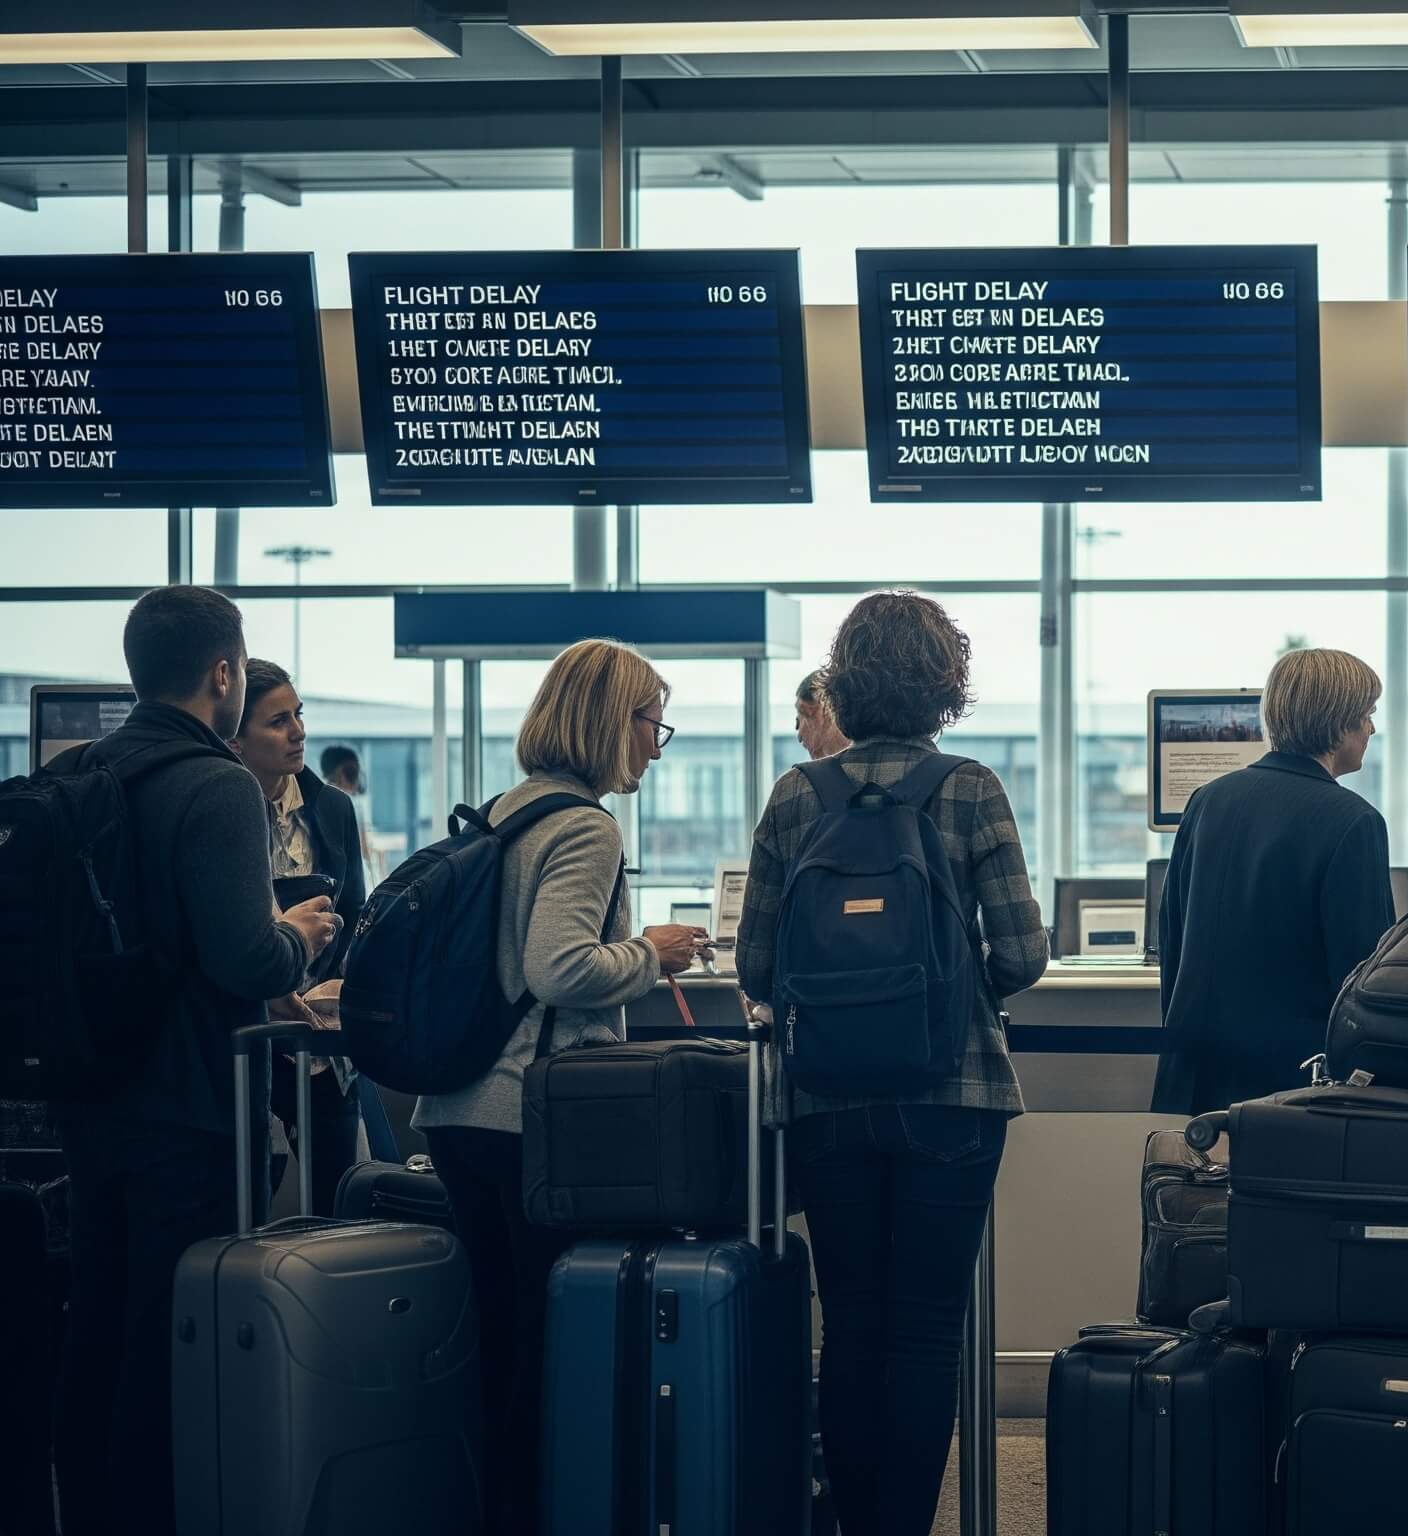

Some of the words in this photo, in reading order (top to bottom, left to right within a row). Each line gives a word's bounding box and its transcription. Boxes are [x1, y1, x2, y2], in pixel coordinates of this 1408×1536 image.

[255, 289, 283, 307] 66
[383, 284, 465, 306] FLIGHT
[469, 284, 541, 306] DELAY
[738, 285, 767, 303] 66
[890, 280, 969, 302] FLIGHT
[974, 280, 1049, 302] DELAY
[1254, 281, 1285, 300] 66
[23, 315, 105, 335] DELAES
[1021, 307, 1105, 328] DELAES
[26, 341, 102, 361] DELARY
[1022, 335, 1101, 355] DELARY
